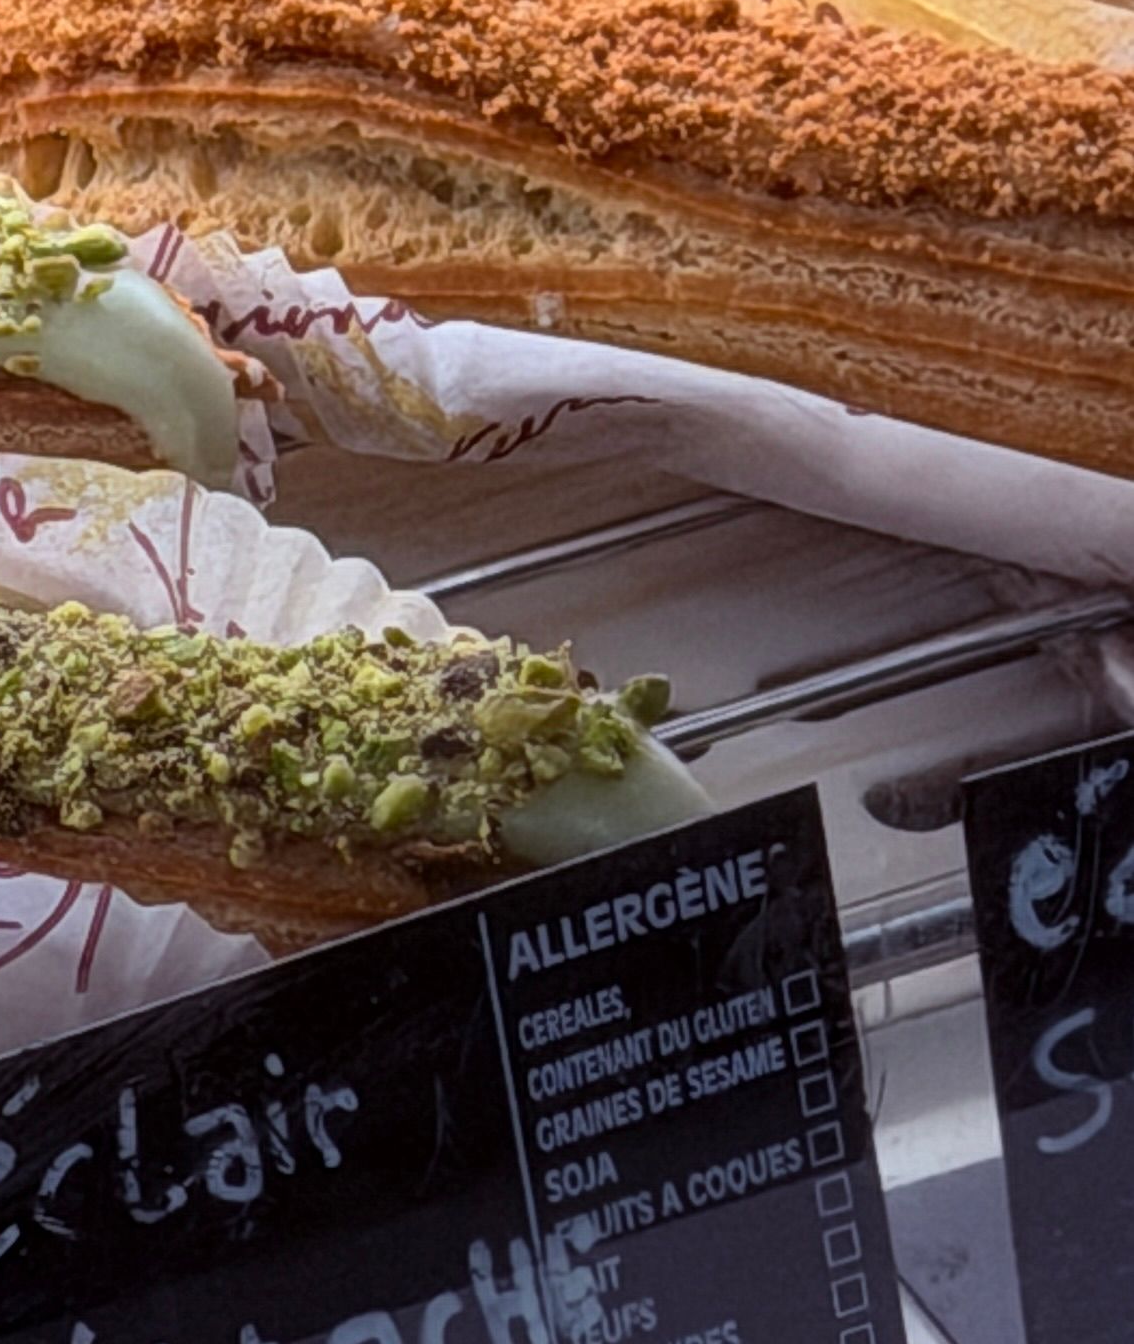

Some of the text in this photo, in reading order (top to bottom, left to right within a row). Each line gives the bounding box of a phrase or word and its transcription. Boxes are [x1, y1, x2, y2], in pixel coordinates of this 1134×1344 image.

[518, 985, 632, 1050] CEREALES,
[527, 985, 777, 1101] CONTENANT DU GLUTEN
[535, 1035, 787, 1152] GRAINES DE SESAME
[544, 1151, 619, 1203] SOJA
[661, 1181, 684, 1217] A
[687, 1140, 804, 1206] COQUES
